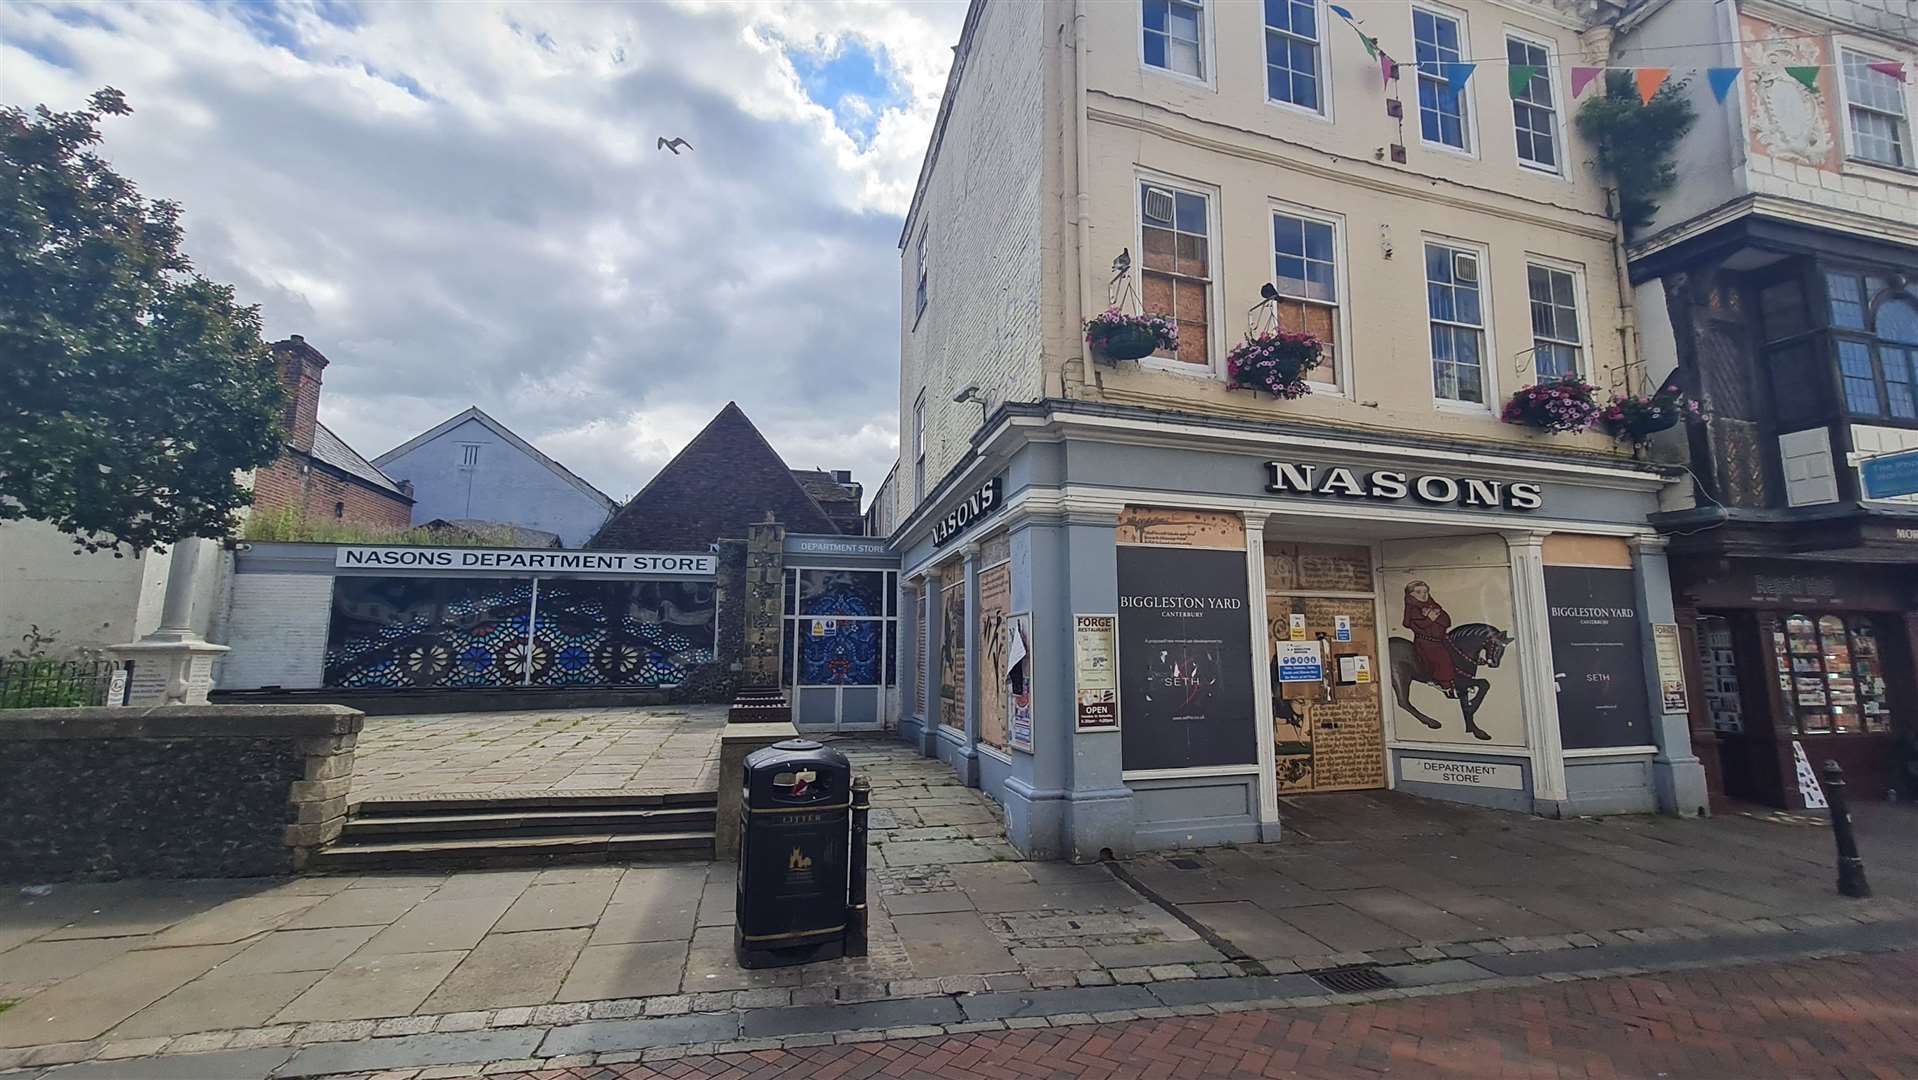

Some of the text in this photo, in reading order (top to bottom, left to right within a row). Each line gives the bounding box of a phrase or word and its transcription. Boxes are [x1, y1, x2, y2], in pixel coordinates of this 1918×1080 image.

[1265, 461, 1543, 511] NASONS
[931, 478, 1001, 547] NASONS
[800, 543, 885, 553] DEPARTMENT STORE
[346, 549, 708, 572] NASONS DEPARTMENT STORE
[1120, 596, 1241, 610] BIGGLESTON YARD
[1551, 607, 1634, 618] BIGGLESTON YARD
[1077, 617, 1112, 628] FORGE
[1164, 677, 1200, 687] SETH
[1586, 673, 1610, 682] SETH
[1085, 705, 1108, 715] OPEN
[1423, 762, 1496, 775] DEPARTMENT
[1442, 772, 1480, 784] STORE
[782, 815, 822, 824] LITTER
